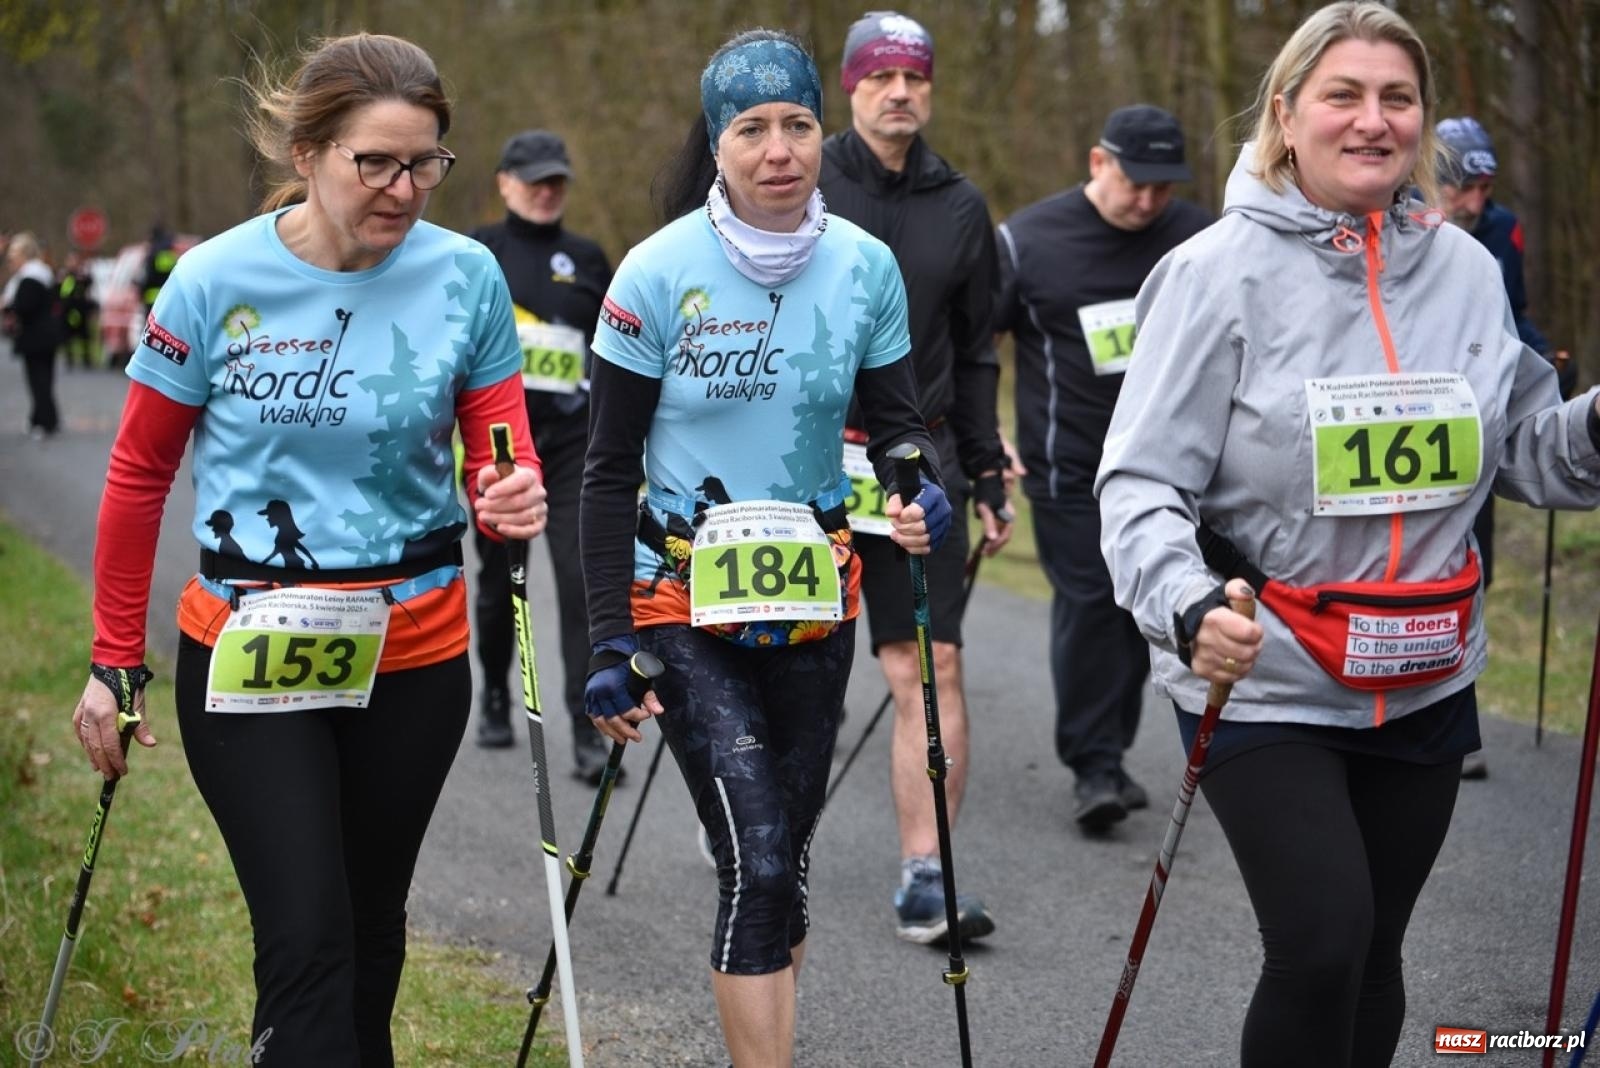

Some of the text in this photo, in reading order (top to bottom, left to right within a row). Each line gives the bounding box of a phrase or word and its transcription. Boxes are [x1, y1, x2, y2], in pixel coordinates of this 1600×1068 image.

[523, 348, 577, 380] 169
[1343, 423, 1458, 488] 161
[714, 545, 820, 599] 184
[1351, 616, 1457, 634] To the doers.
[242, 634, 357, 689] 153
[1350, 637, 1369, 653] To
[1374, 639, 1398, 654] the
[1347, 660, 1366, 675] To
[1370, 661, 1395, 675] the
